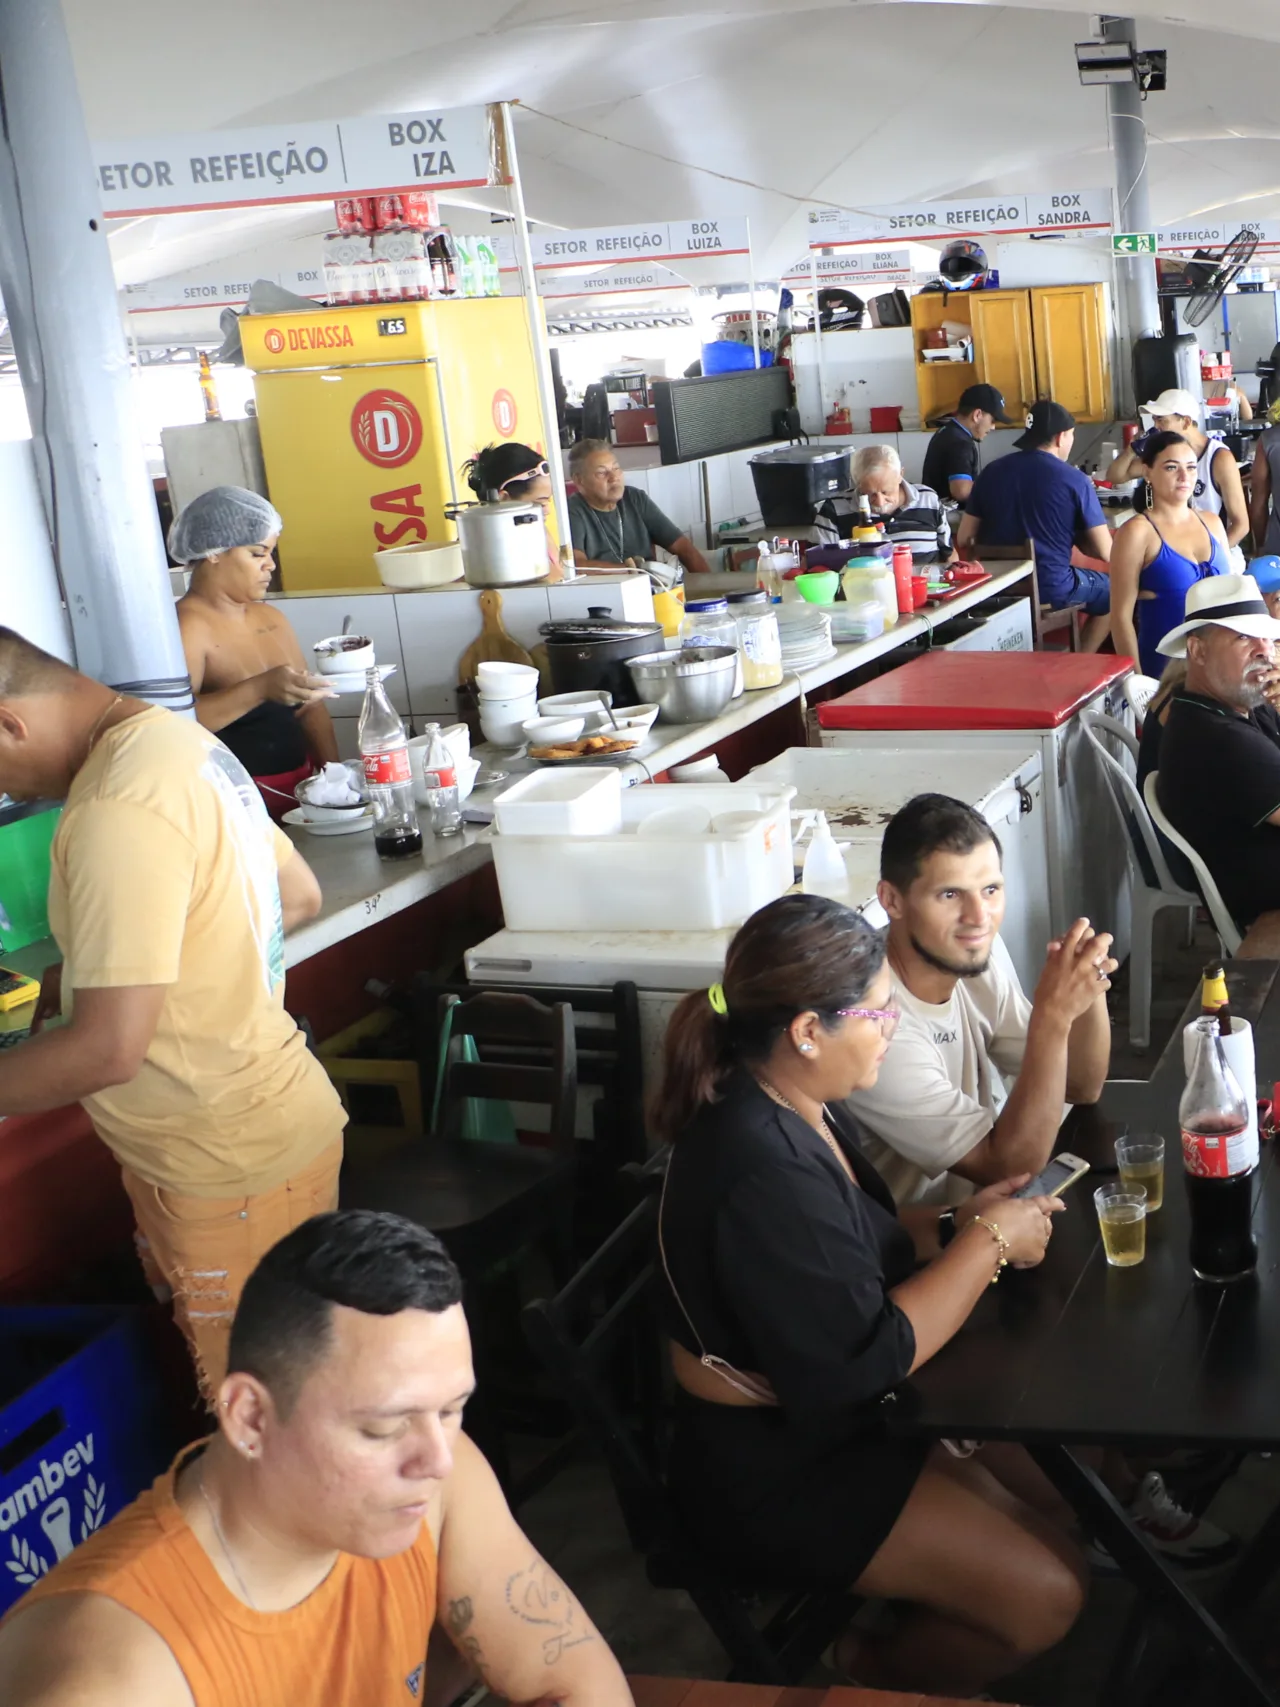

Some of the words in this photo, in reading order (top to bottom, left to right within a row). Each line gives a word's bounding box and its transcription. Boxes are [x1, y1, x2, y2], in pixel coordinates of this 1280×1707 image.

[388, 118, 446, 147] BOX
[97, 160, 174, 191] ETOR
[190, 141, 329, 184] REFEIÇÃO
[413, 150, 456, 177] IZA
[1051, 194, 1080, 207] BOX
[889, 213, 936, 229] SETOR
[946, 204, 1019, 224] REFEIÇÃO
[1038, 213, 1091, 226] SANDRA
[692, 222, 719, 234] BOX
[1241, 223, 1261, 232] BOX
[1170, 228, 1220, 243] REFEIÇÃO
[545, 240, 588, 255] SETOR
[597, 232, 662, 251] REFEIÇÃO
[687, 236, 722, 250] LUIZA
[875, 252, 892, 260] BOX
[789, 263, 811, 272] ETOR
[816, 259, 858, 270] REFEIÇÃO
[872, 261, 899, 270] ELIANA
[297, 271, 319, 281] BOX
[584, 279, 610, 288] SETOR
[615, 275, 653, 287] REFEIÇÃO
[184, 285, 218, 298] SETOR
[288, 325, 354, 351] DEVASSA
[0, 1433, 94, 1531] ambev
